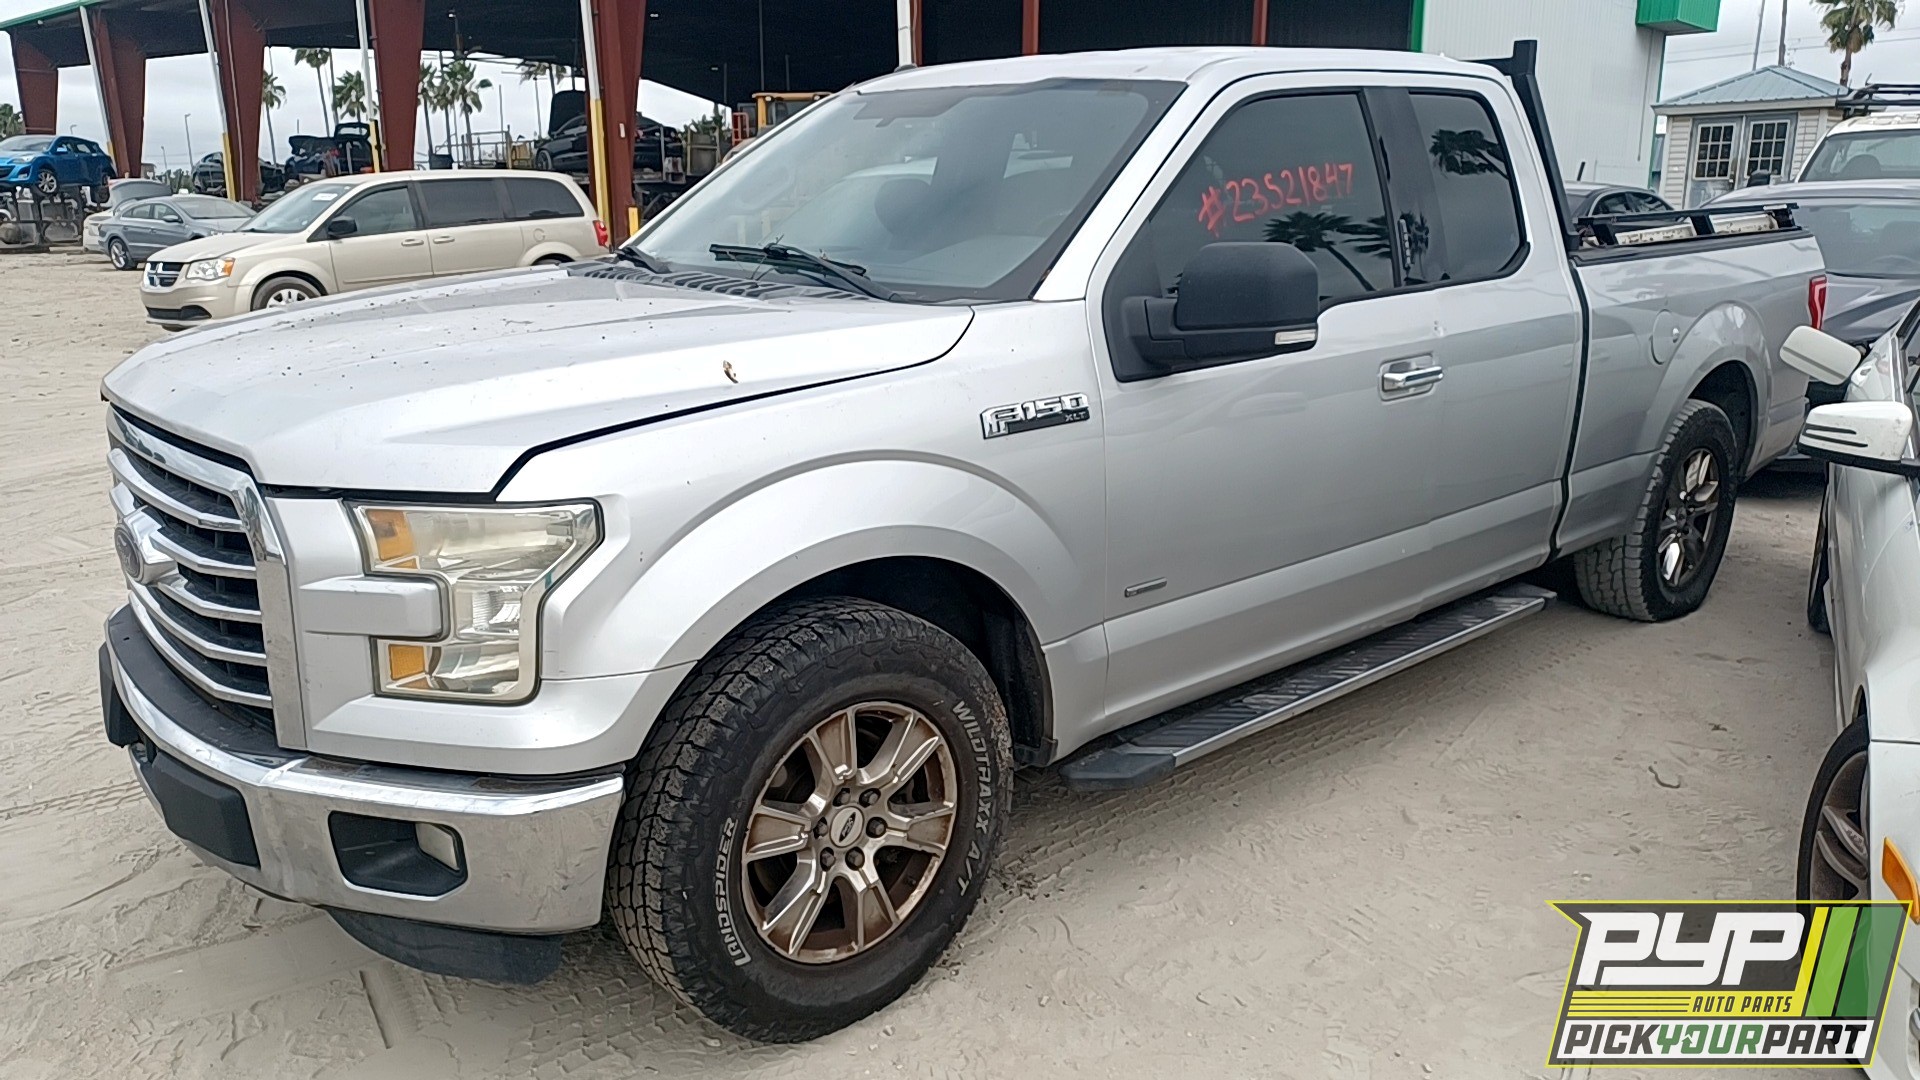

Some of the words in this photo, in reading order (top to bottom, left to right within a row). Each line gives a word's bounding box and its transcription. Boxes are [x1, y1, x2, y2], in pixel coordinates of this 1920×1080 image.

[1064, 411, 1086, 422] XLT
[952, 700, 992, 834] WILDTRAXX
[714, 817, 751, 966] LANDSPIDER
[958, 840, 980, 896] A/T
